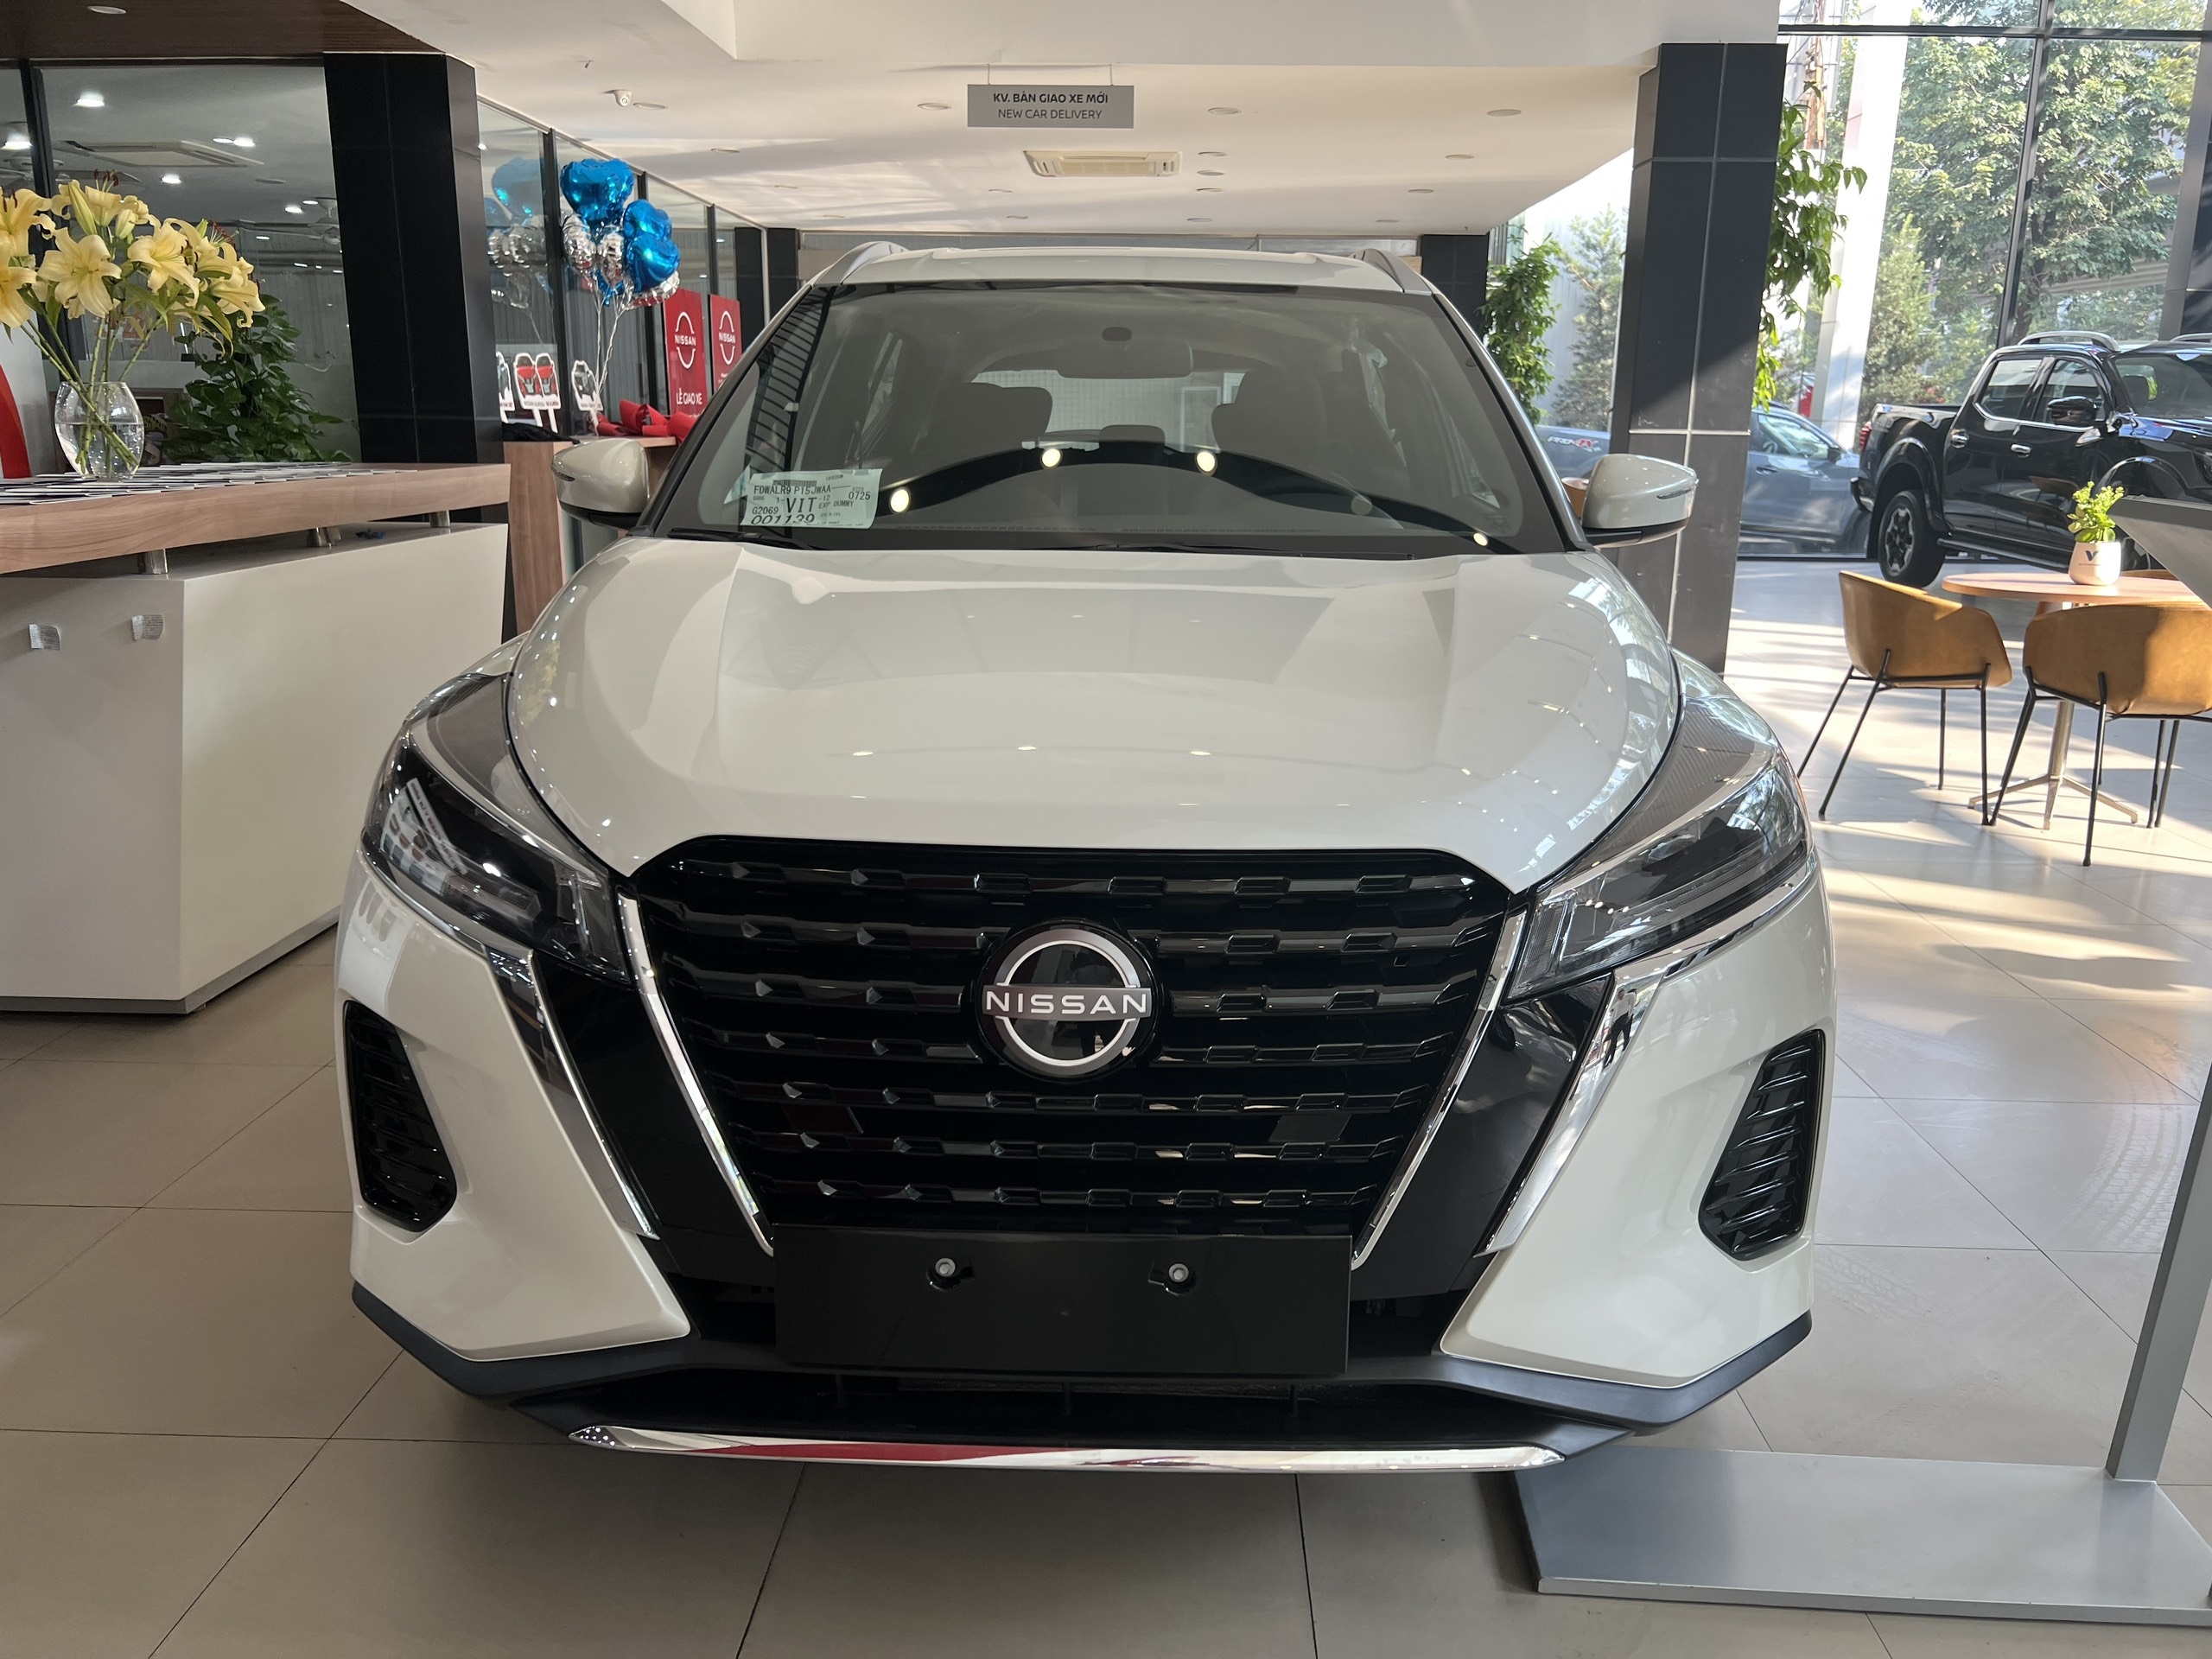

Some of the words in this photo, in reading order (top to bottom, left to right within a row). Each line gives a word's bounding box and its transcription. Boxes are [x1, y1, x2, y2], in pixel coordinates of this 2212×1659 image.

[994, 93, 1011, 103] KV.
[1039, 93, 1066, 104] GIAO
[1069, 94, 1084, 104] XE
[1086, 91, 1109, 104] MỚI
[998, 109, 1023, 118] NEW
[1025, 110, 1048, 119] CAR
[1050, 110, 1103, 119] DELIVERY
[675, 334, 696, 346] NISSAN
[719, 332, 736, 344] NISSAN
[848, 491, 871, 500] 0725
[752, 506, 779, 515] G2069
[786, 497, 817, 513] VIT
[986, 990, 1147, 1015] NISSAN
